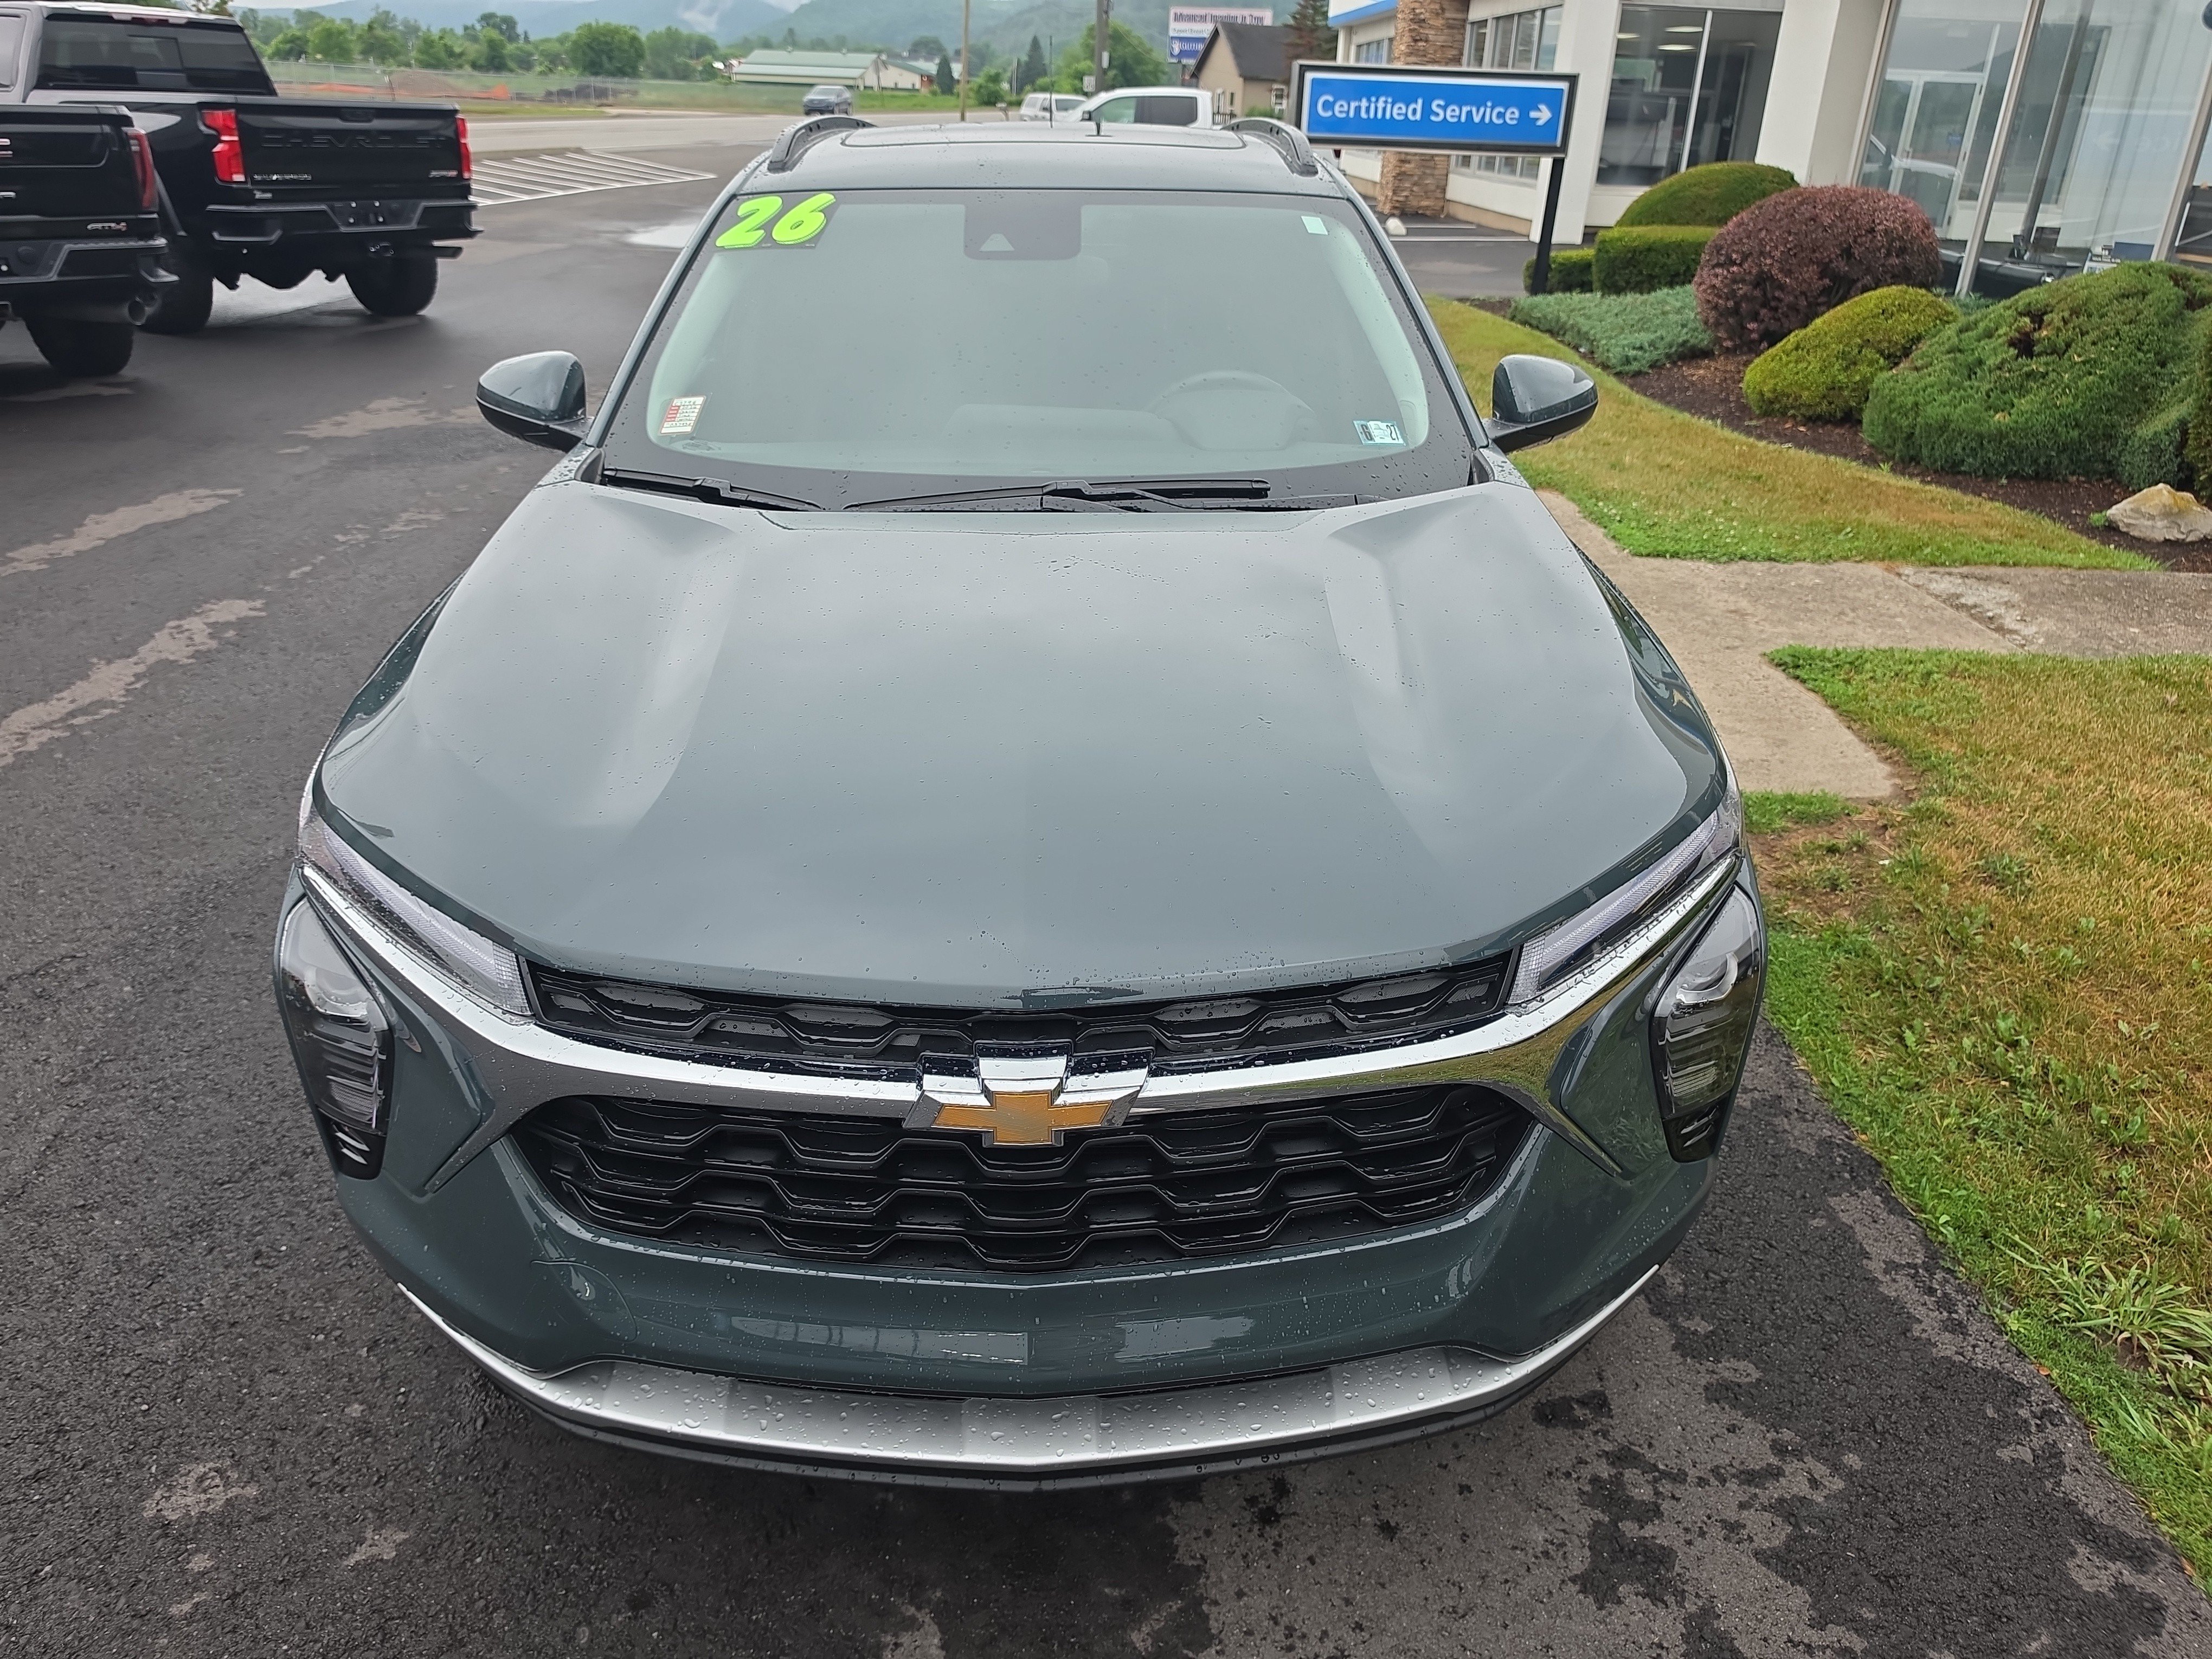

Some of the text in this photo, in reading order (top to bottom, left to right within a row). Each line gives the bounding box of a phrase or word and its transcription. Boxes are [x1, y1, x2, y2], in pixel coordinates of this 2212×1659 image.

[1316, 94, 1520, 125] Certified Service
[715, 192, 837, 249] 26
[1360, 423, 1399, 442] 6 27
